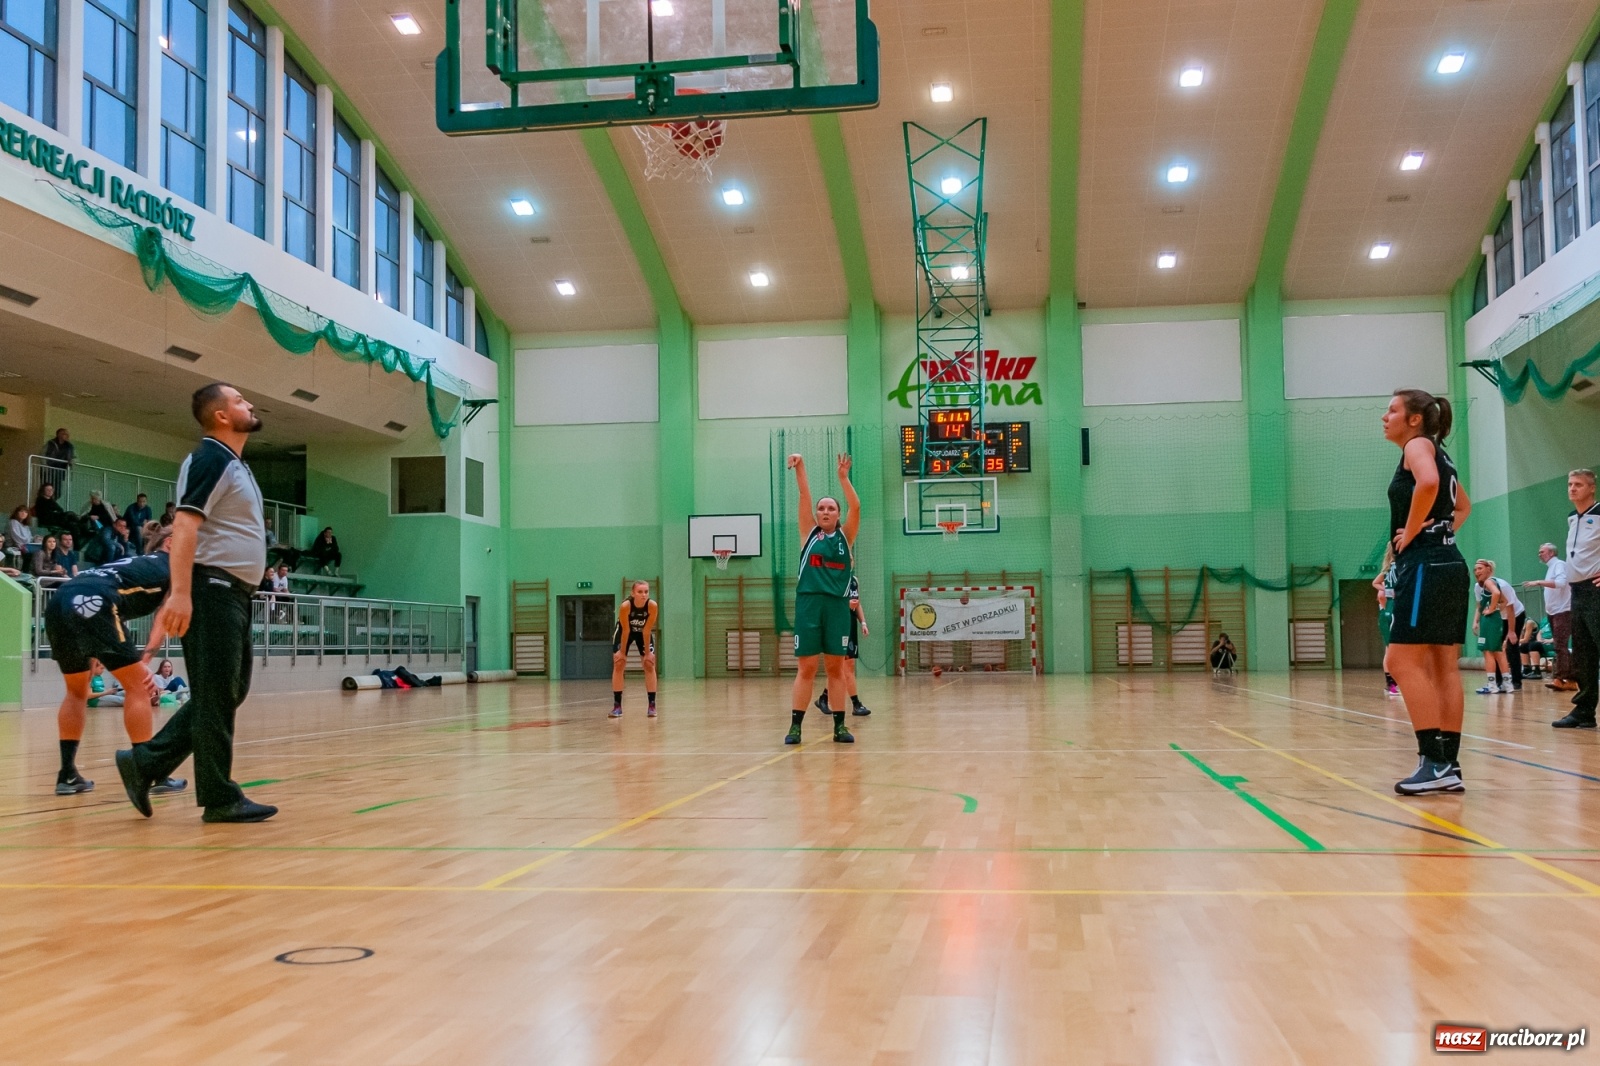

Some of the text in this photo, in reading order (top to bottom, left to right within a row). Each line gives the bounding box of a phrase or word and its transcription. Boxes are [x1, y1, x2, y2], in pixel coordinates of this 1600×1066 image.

[0, 117, 196, 242] REKREACJI RACIBÓRZ
[932, 459, 950, 472] 51
[986, 458, 1004, 470] 35
[941, 621, 961, 634] JEST
[962, 618, 970, 627] W
